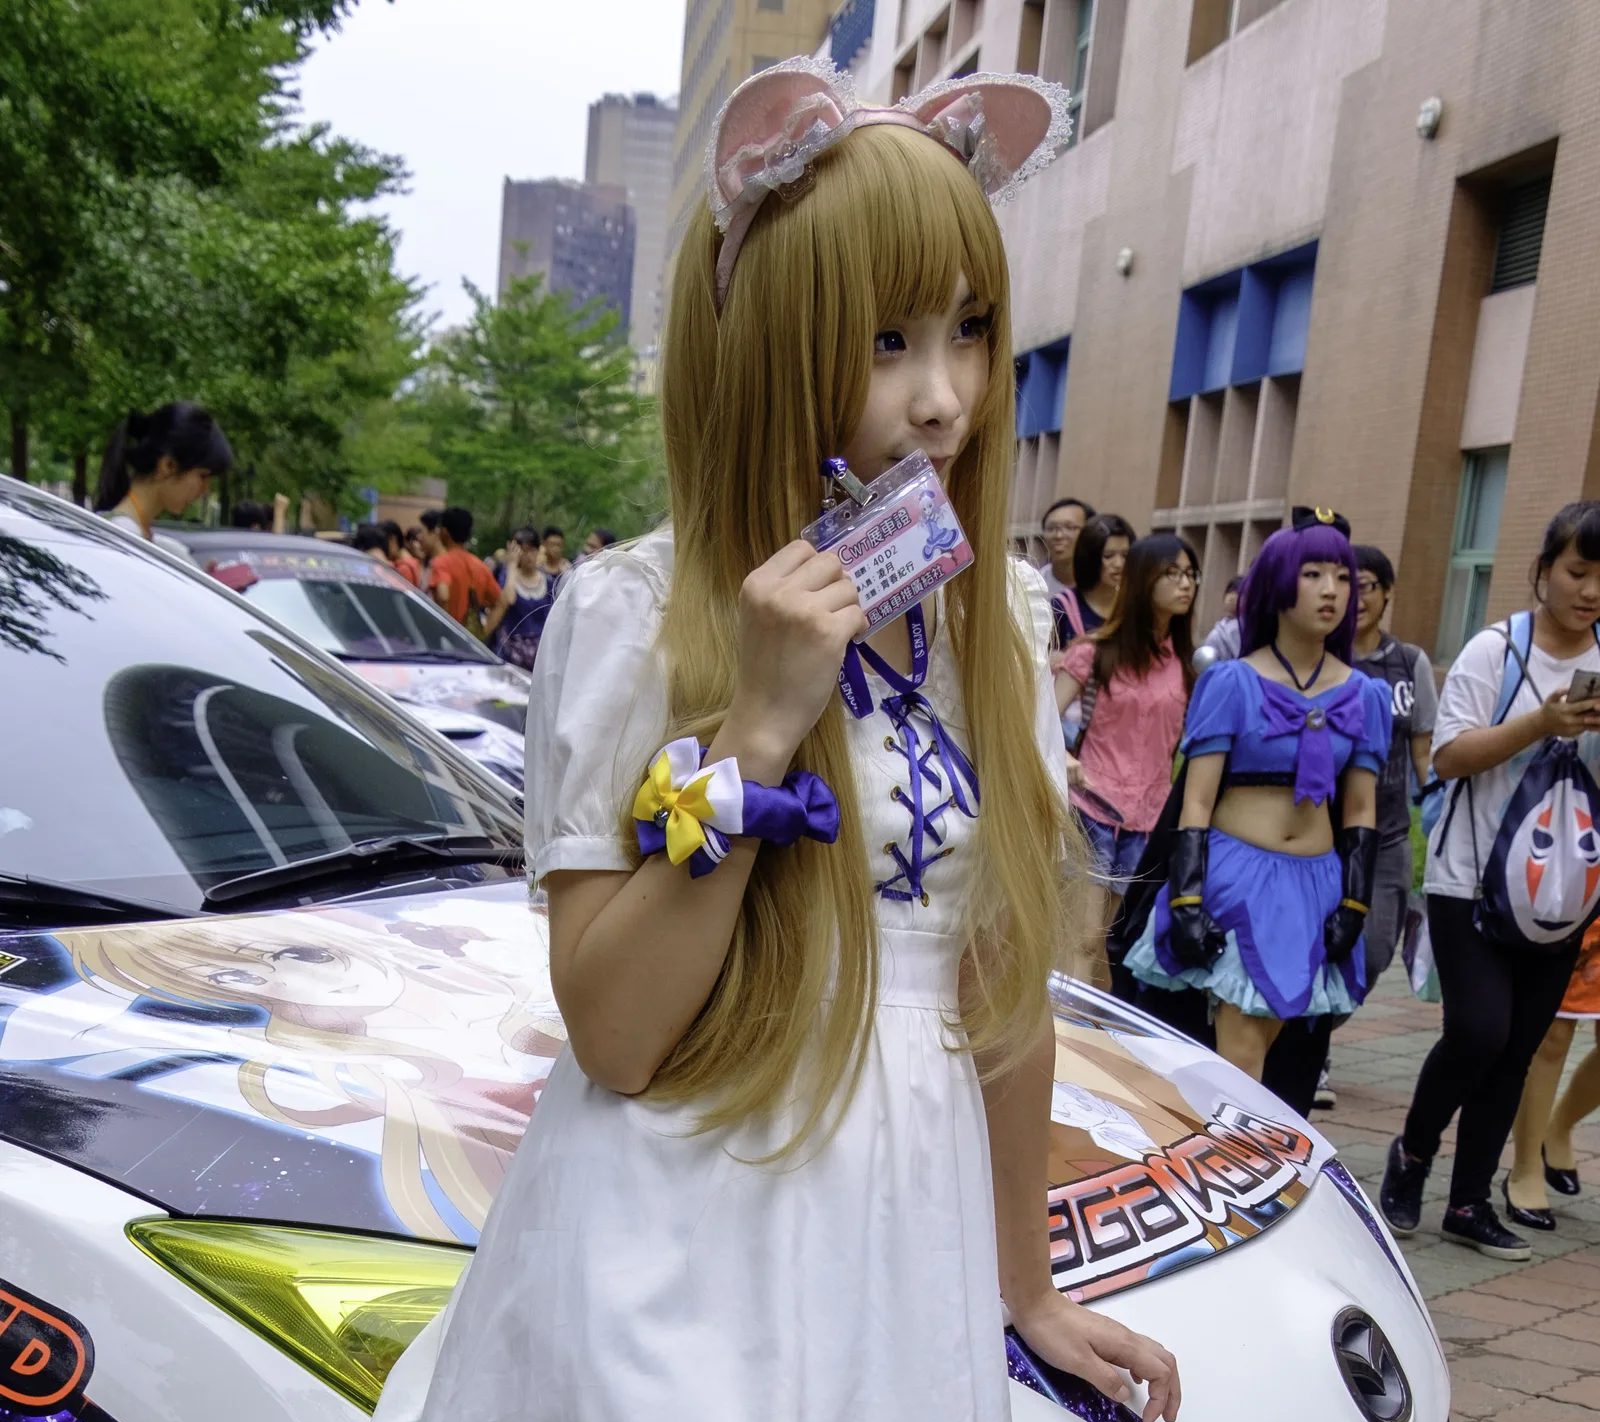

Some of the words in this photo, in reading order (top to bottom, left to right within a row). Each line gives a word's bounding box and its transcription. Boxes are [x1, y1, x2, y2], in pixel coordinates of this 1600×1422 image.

[838, 507, 911, 565] CWT展車證
[873, 554, 884, 567] 40
[884, 545, 898, 559] D2
[876, 562, 895, 580] 凌月
[911, 623, 924, 650] ENJOY
